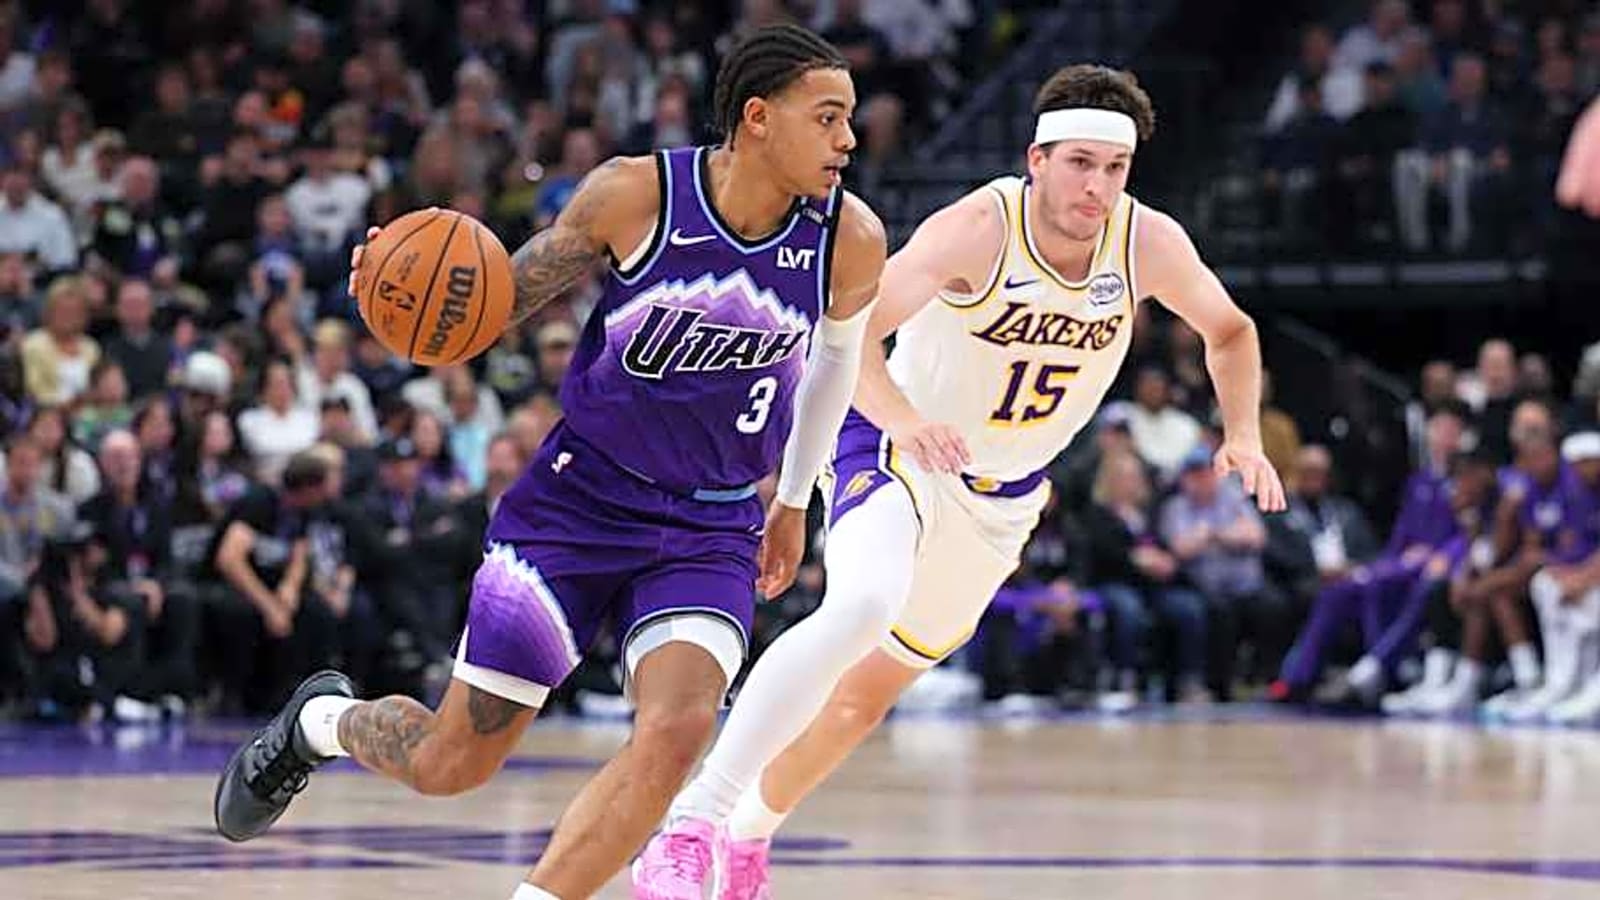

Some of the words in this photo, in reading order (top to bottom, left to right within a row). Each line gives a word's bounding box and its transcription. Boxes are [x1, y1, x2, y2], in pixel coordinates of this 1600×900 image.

[776, 246, 816, 271] LVT
[422, 266, 477, 356] Wilson
[622, 303, 806, 380] UTAH
[970, 301, 1124, 351] LAKERS
[735, 376, 778, 434] 3
[988, 360, 1081, 427] 15
